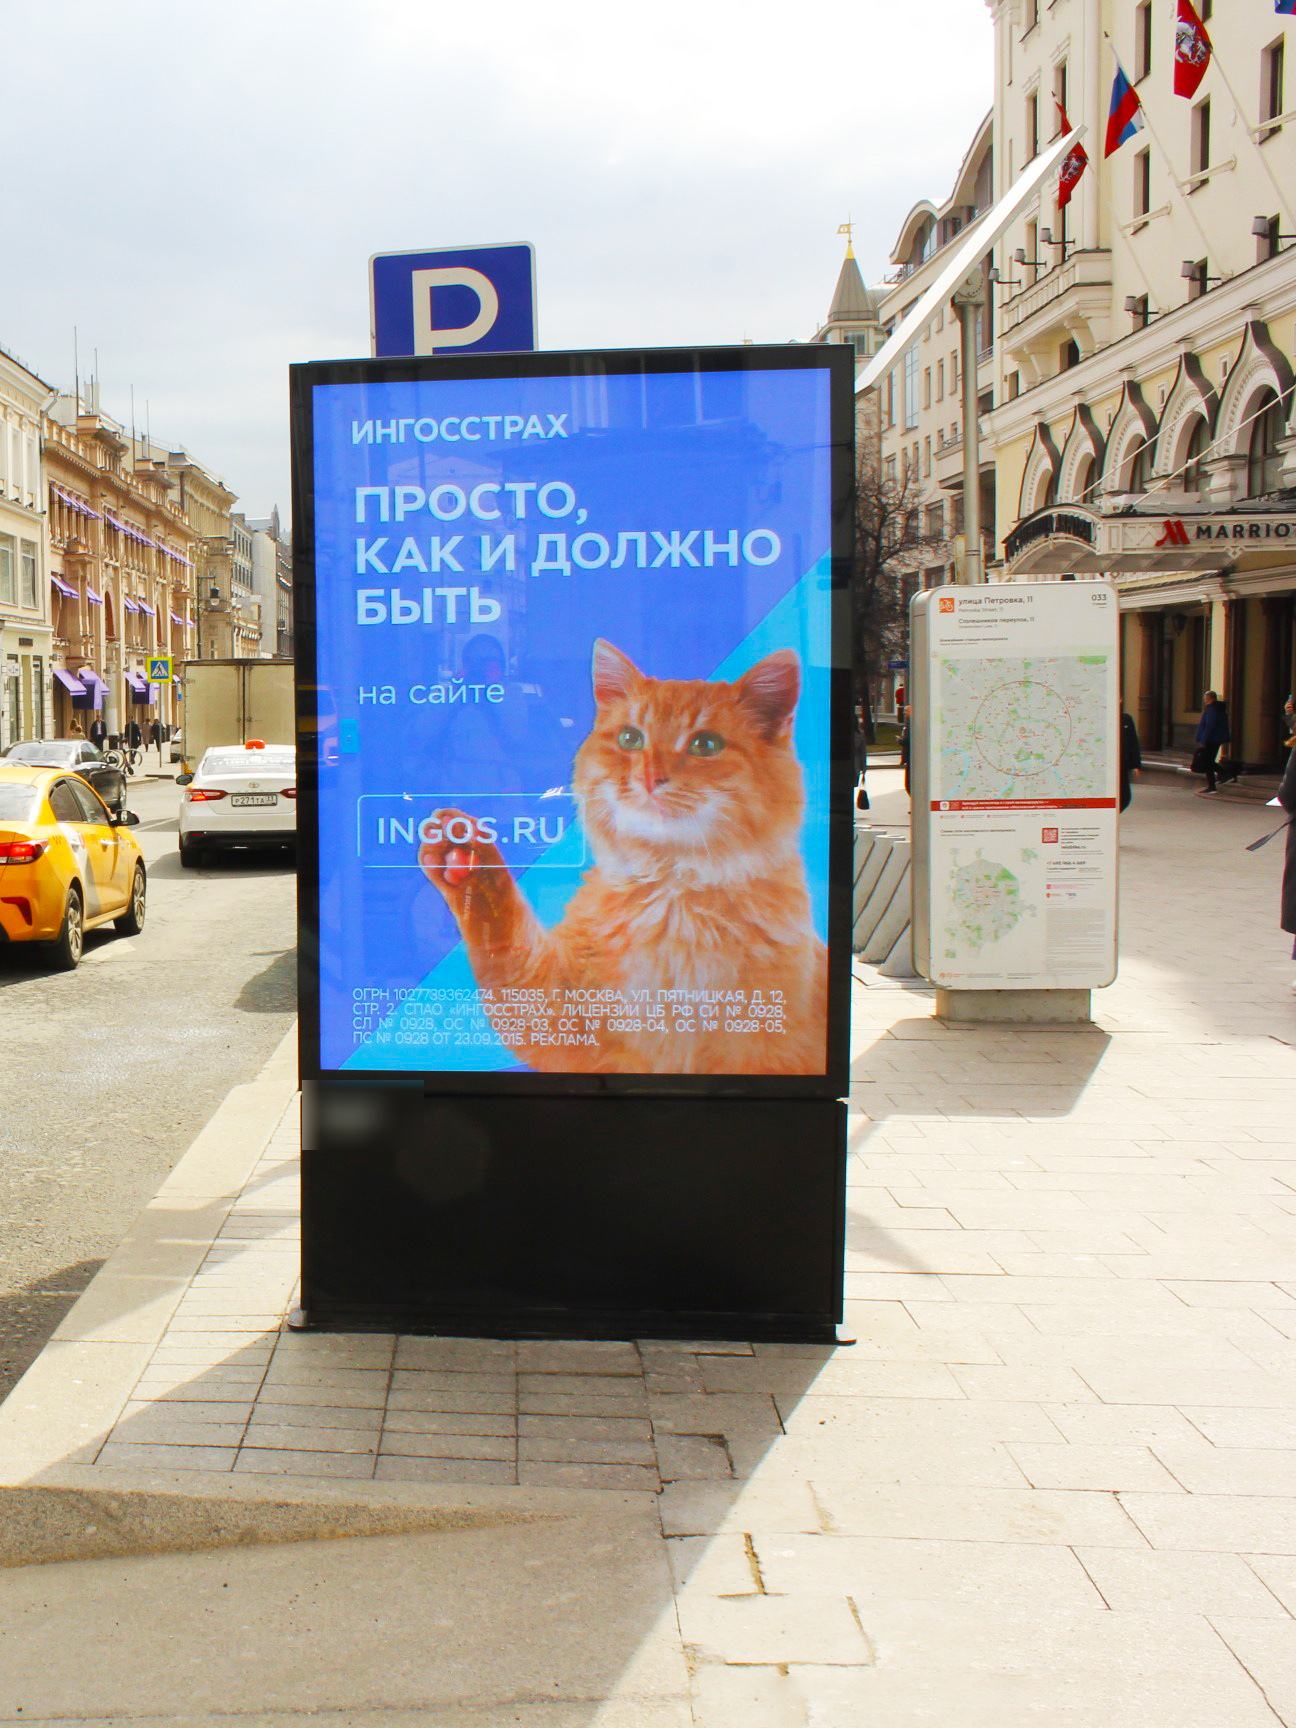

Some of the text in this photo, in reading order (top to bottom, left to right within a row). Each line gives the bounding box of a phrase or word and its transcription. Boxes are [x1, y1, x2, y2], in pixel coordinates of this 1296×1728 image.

[412, 267, 499, 356] P
[352, 413, 569, 444] ИНГОССТРАХ
[356, 481, 588, 526] ПРОСТО,
[1196, 522, 1296, 540] MARRIO
[356, 528, 782, 577] КАК И ДОЛЖНО
[357, 587, 501, 626] БЫТЬ
[959, 598, 982, 606] улица
[984, 597, 1025, 606] Петровка,
[1091, 594, 1107, 602] 033
[359, 678, 504, 704] на сайте
[378, 816, 564, 845] INGOS.RU
[353, 988, 390, 1001] ОГРН
[501, 989, 548, 1003] 115035,
[552, 989, 561, 1002] Г.
[565, 989, 627, 1003] МОСКВА,
[631, 990, 653, 1002] УЛ.
[657, 989, 748, 1004] ПЯТНИЦКАЯ,
[751, 990, 766, 1004] Д.
[769, 990, 787, 1004] 12,
[353, 1003, 787, 1019] СТР. 2. СПАО «ИНГОССТРАХ». ЛИЦЕНЗИИ ЦБ РФ СИ № 0928,
[353, 1017, 787, 1034] СЛ № 0928, ОС № 0928-03, ОС № 0928-04, ОС № 0928-05,
[353, 1031, 600, 1046] ПС № 0928 ОТ 23.09.2015. РЕКЛАМА.
